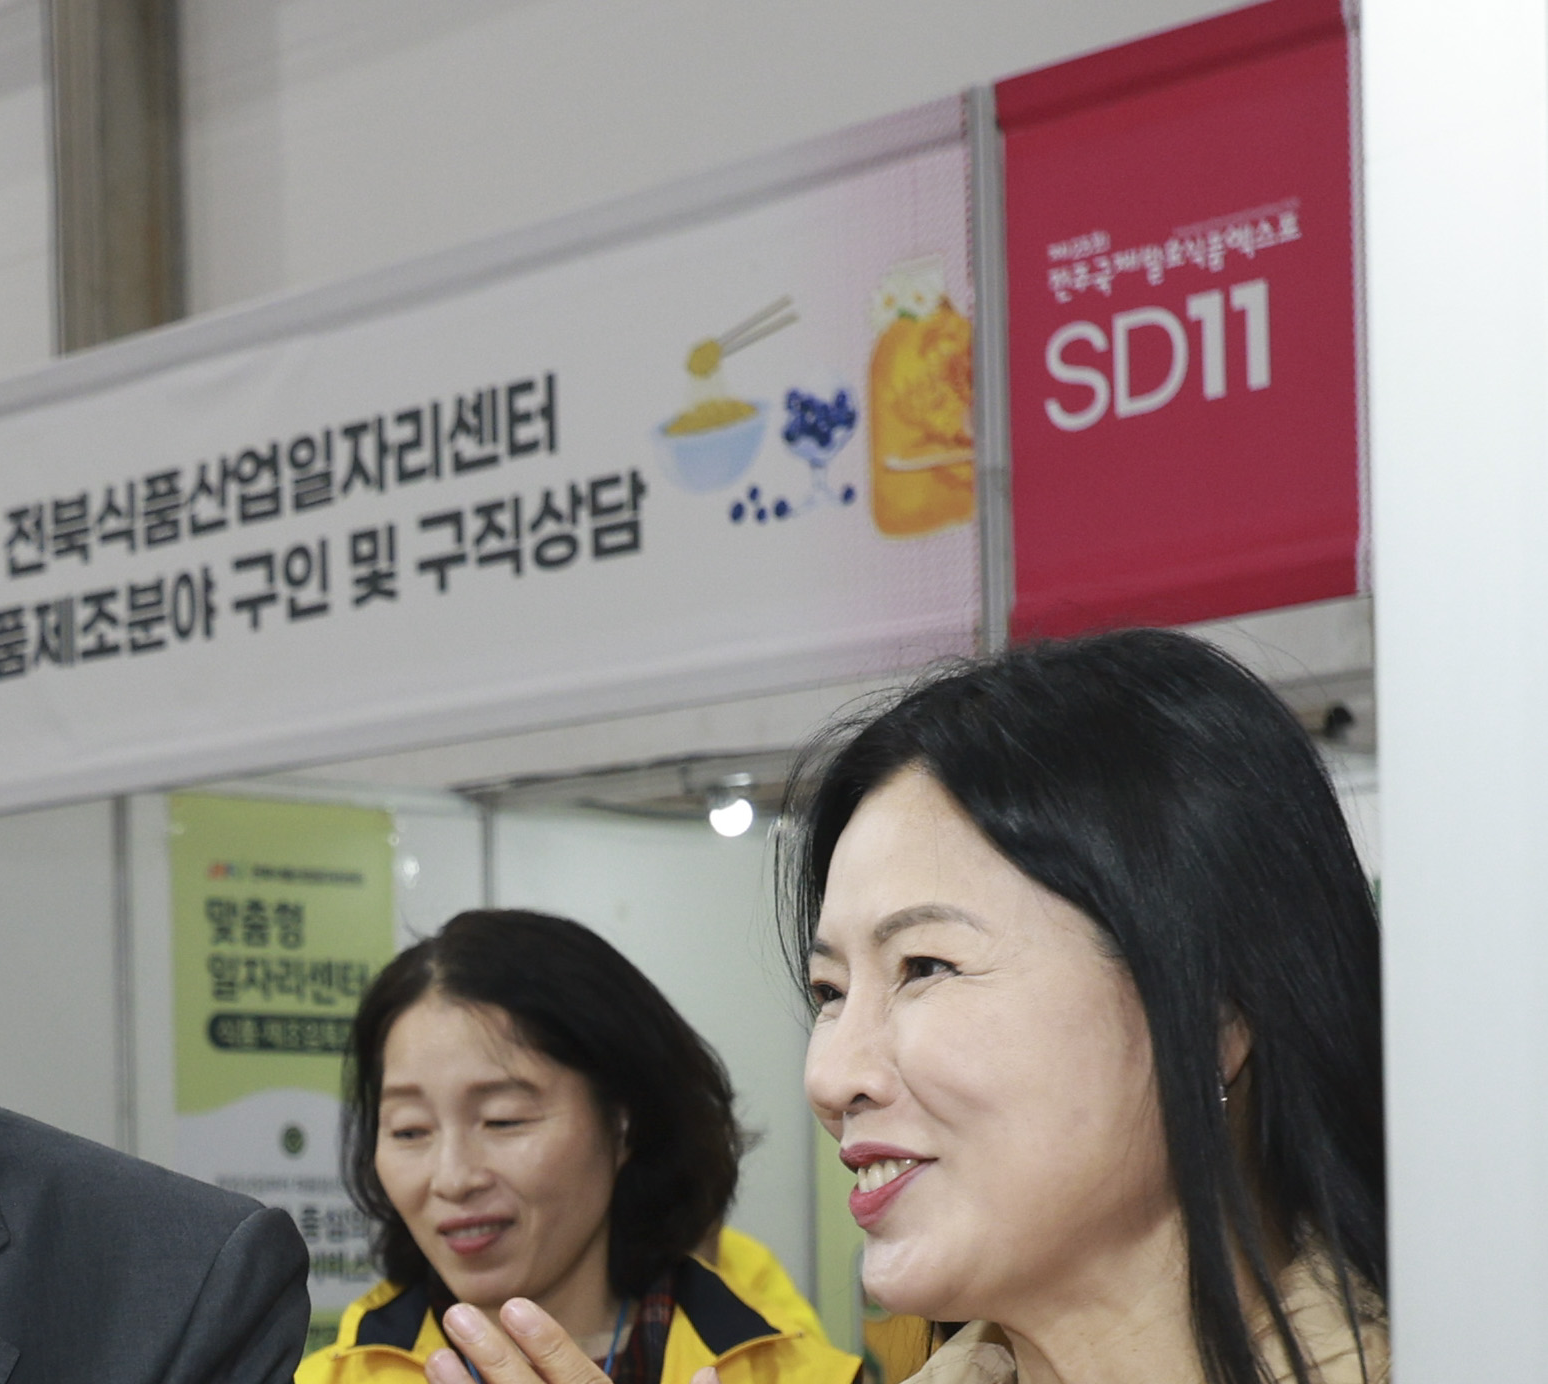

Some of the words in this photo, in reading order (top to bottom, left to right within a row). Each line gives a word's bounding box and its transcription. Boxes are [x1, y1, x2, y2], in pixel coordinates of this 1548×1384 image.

[1045, 278, 1272, 433] SD11
[4, 373, 558, 578] 전북식품산업일자리센터
[231, 539, 331, 631] 구인
[350, 523, 398, 608] 및
[417, 471, 646, 592] 구직상담
